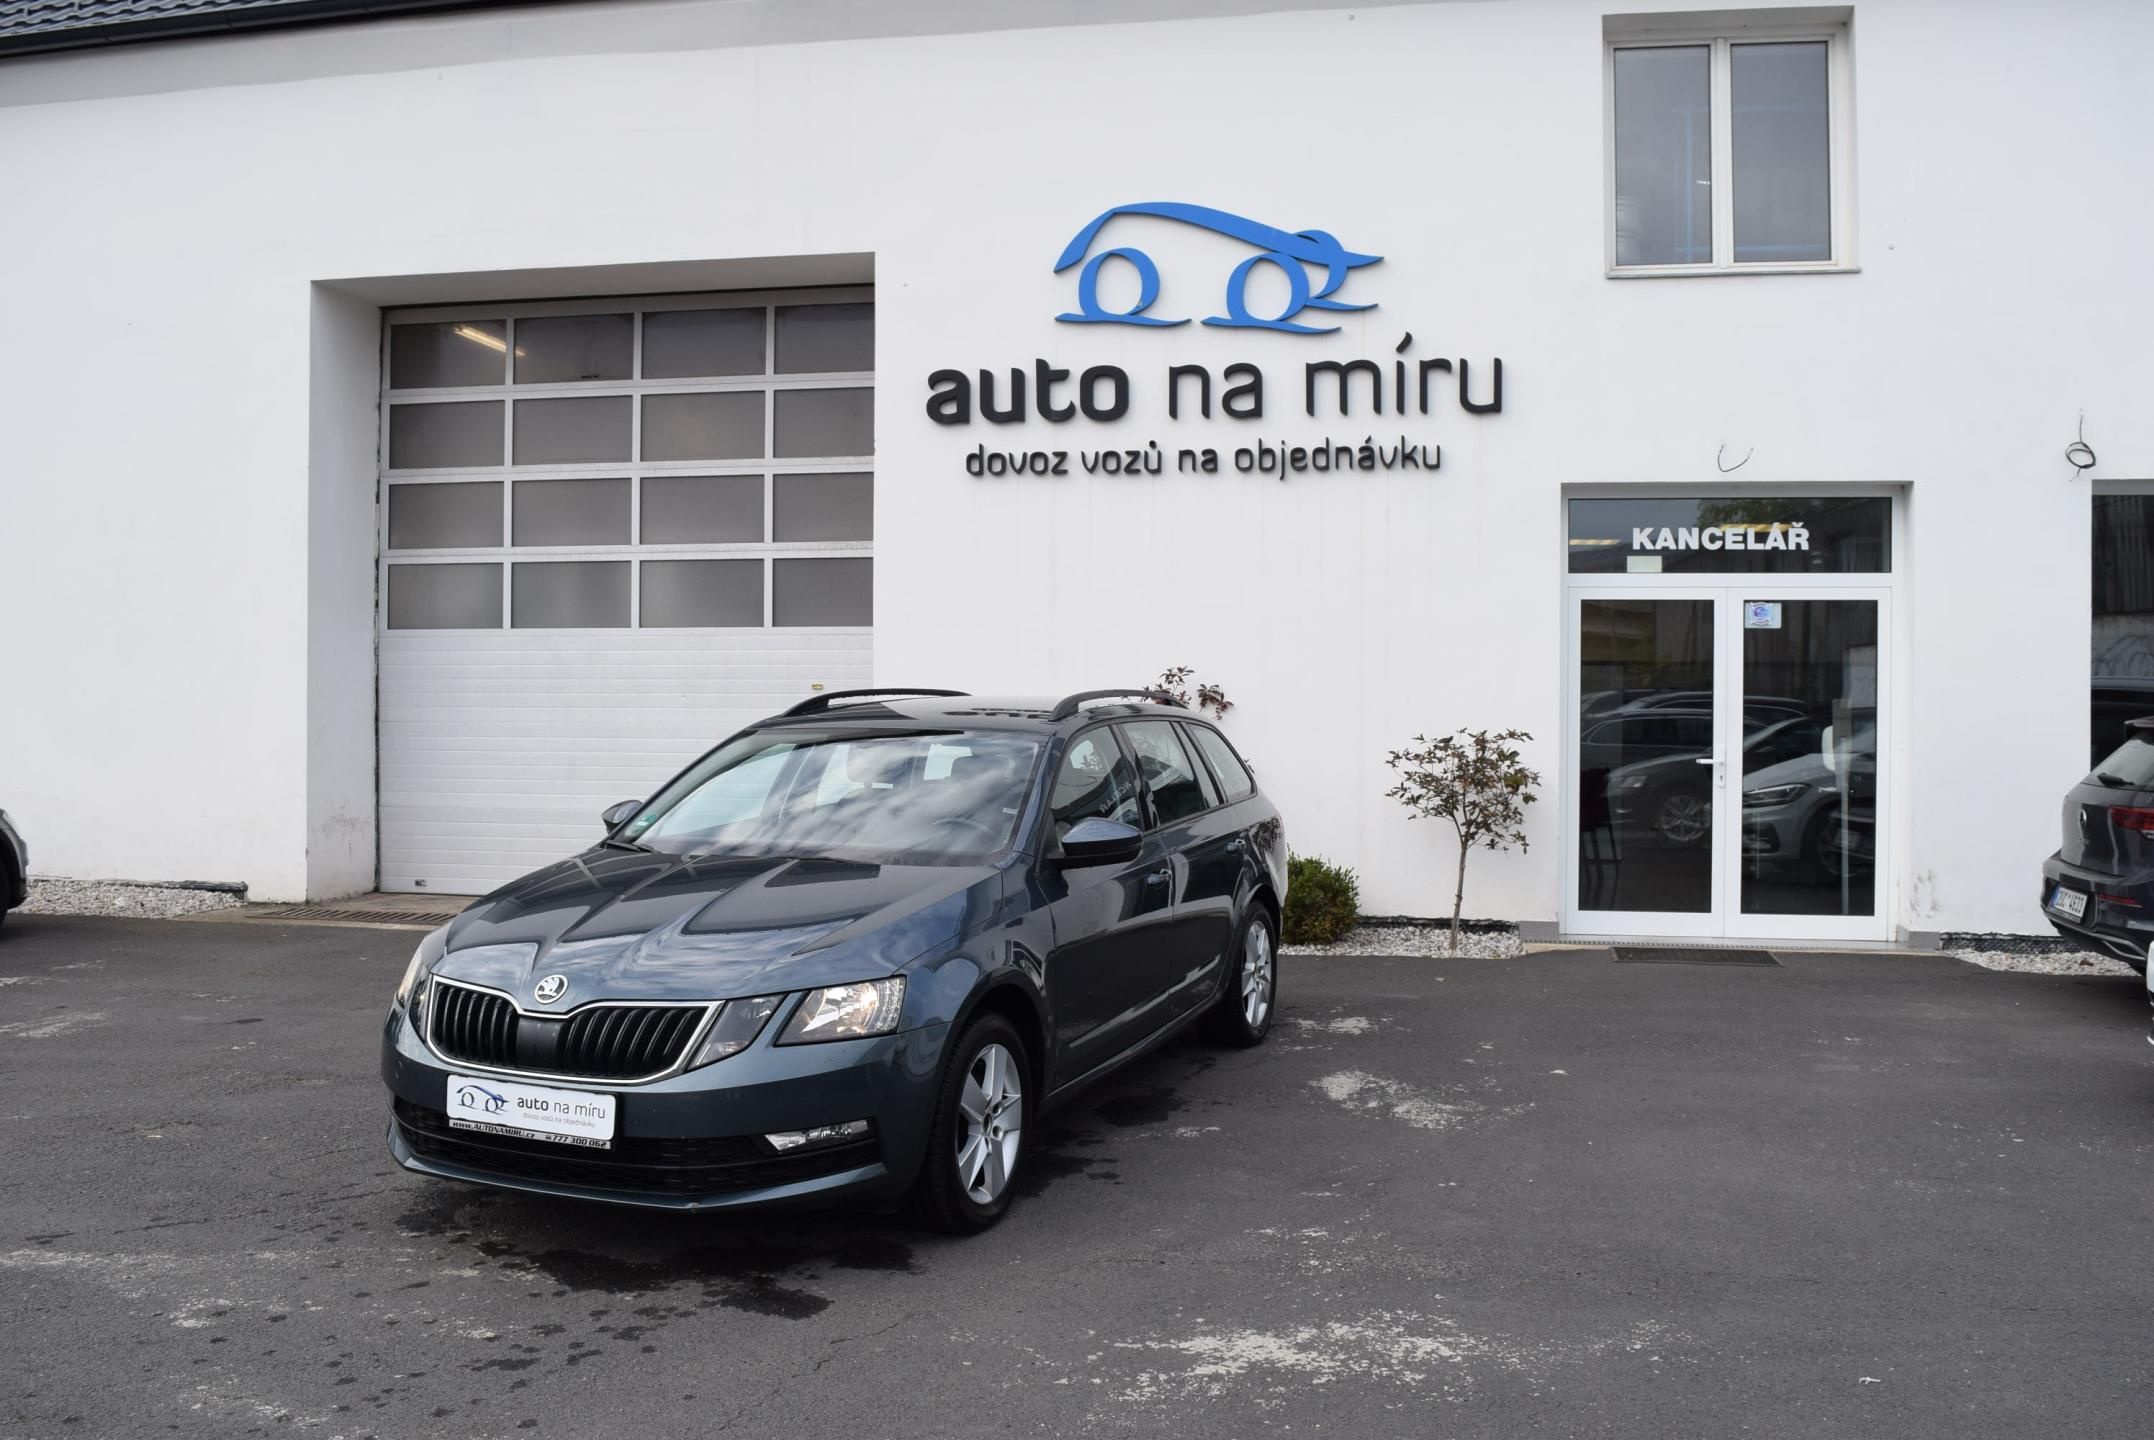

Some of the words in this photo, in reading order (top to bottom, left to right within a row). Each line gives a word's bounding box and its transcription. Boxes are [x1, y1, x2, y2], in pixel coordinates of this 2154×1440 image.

[926, 358, 1130, 425] auto
[1168, 362, 1263, 419] na
[1305, 332, 1503, 417] míru
[966, 443, 1068, 476] dovoz
[1081, 440, 1162, 475] vozů
[1178, 447, 1219, 473] na
[1234, 435, 1441, 480] objednávku
[1632, 522, 1809, 550] KANCELÁŘ
[517, 1097, 549, 1111] auto
[554, 1102, 570, 1114] na
[574, 1102, 606, 1119] míru
[552, 1135, 568, 1143] 777
[570, 1137, 588, 1146] 300
[588, 1140, 607, 1148] 062
